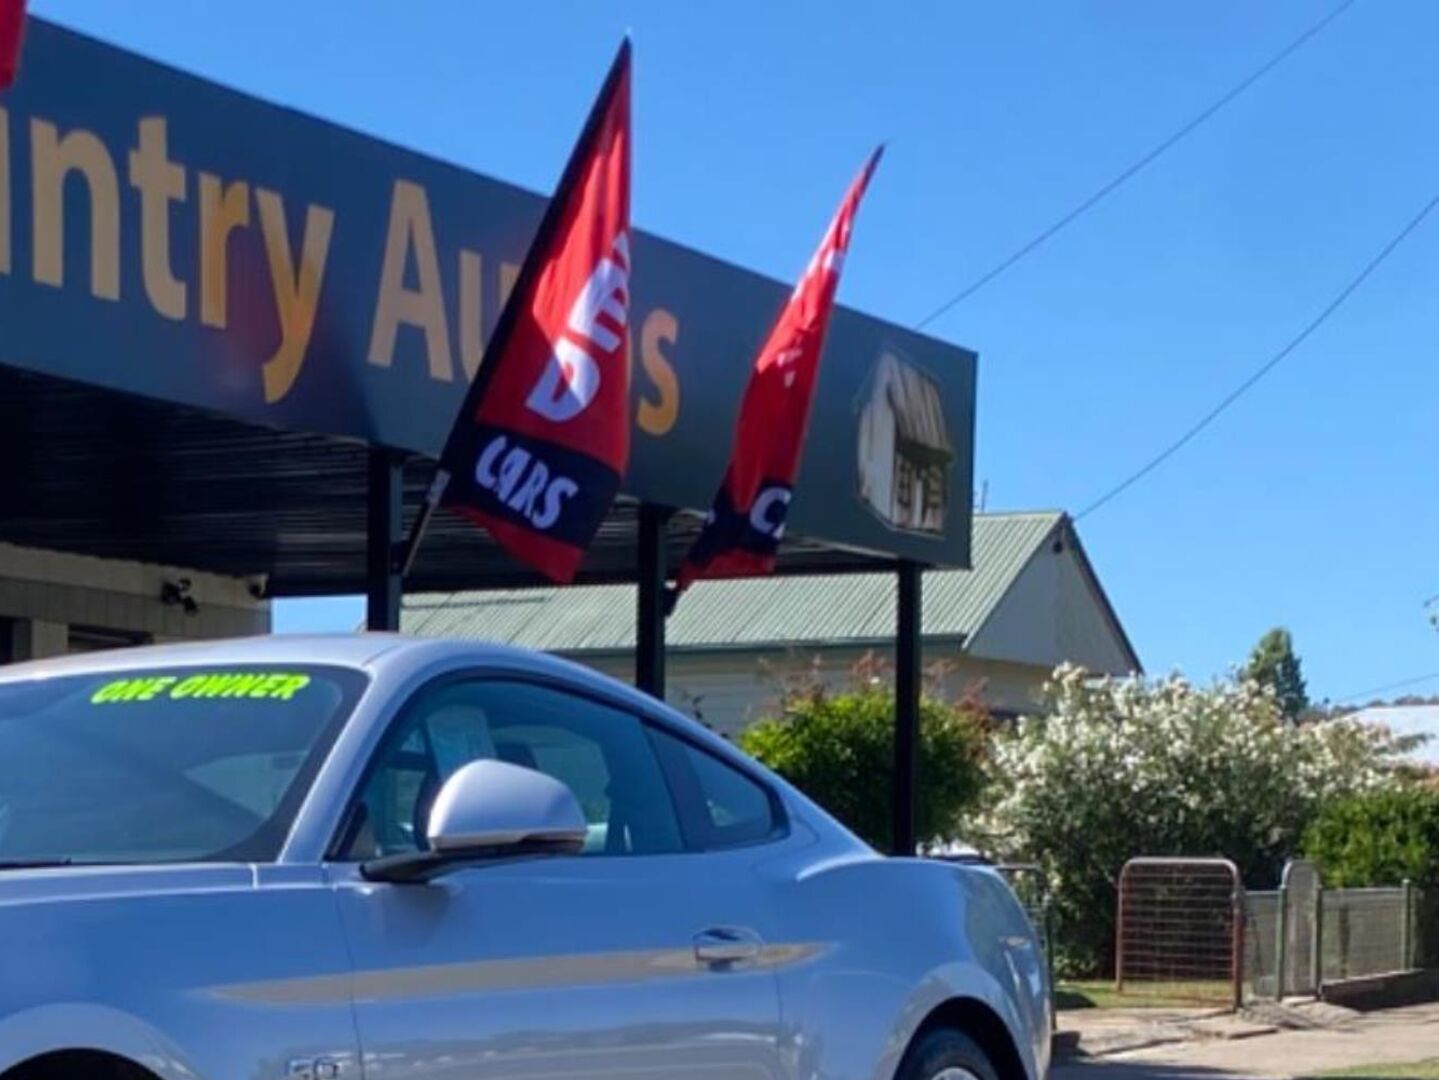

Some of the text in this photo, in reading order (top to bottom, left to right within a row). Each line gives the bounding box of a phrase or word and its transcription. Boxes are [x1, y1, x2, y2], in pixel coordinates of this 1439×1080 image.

[475, 435, 579, 530] CARS
[91, 673, 310, 704] ONE OWNER
